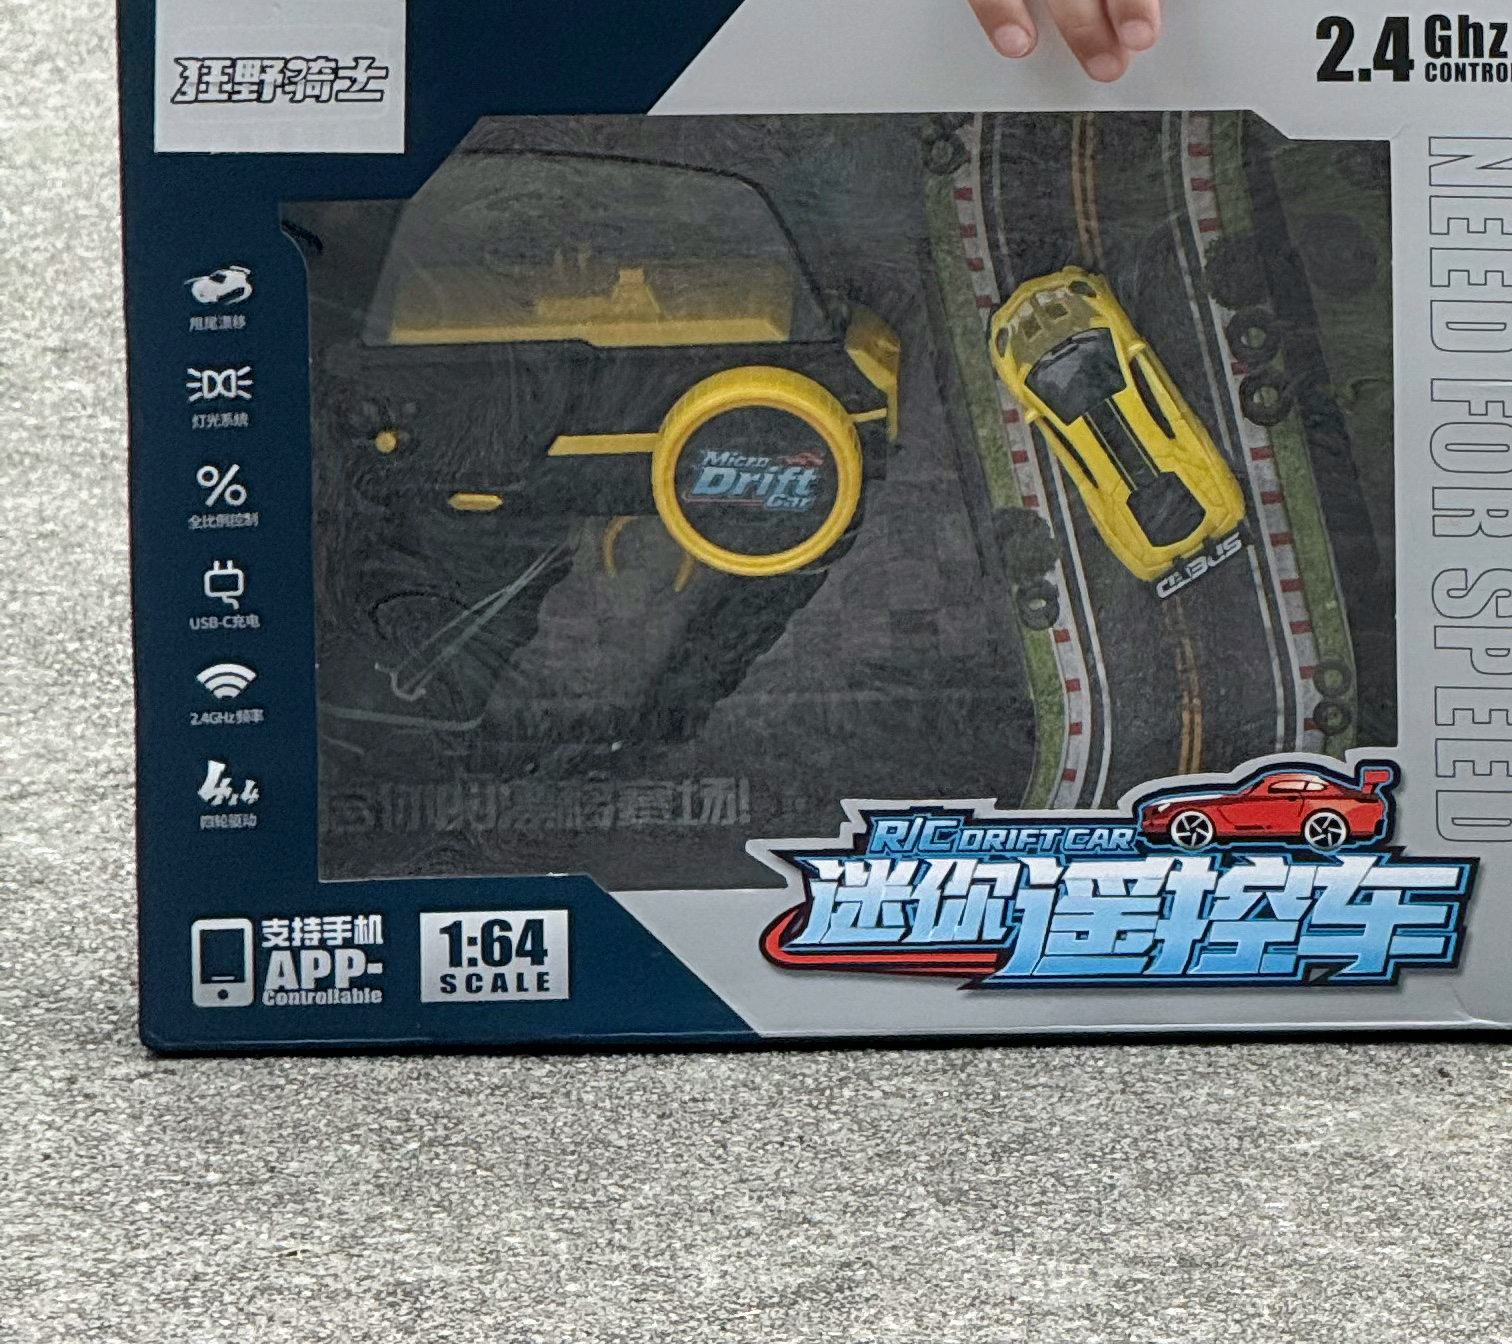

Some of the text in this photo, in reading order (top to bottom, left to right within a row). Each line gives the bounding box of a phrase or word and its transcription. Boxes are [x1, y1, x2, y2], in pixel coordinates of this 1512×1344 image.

[1315, 14, 1508, 83] 2.4 Ghz
[170, 56, 389, 104] 狂野骑士
[692, 465, 817, 497] Drift
[765, 494, 814, 510] Car
[870, 815, 1138, 853] R/C DRIFT CAR
[261, 914, 384, 947] 支持手机
[798, 853, 1465, 977] 迷你遥控车
[439, 918, 548, 968] 1:64
[262, 987, 384, 1006] Controllable
[440, 971, 551, 994] SCALE
